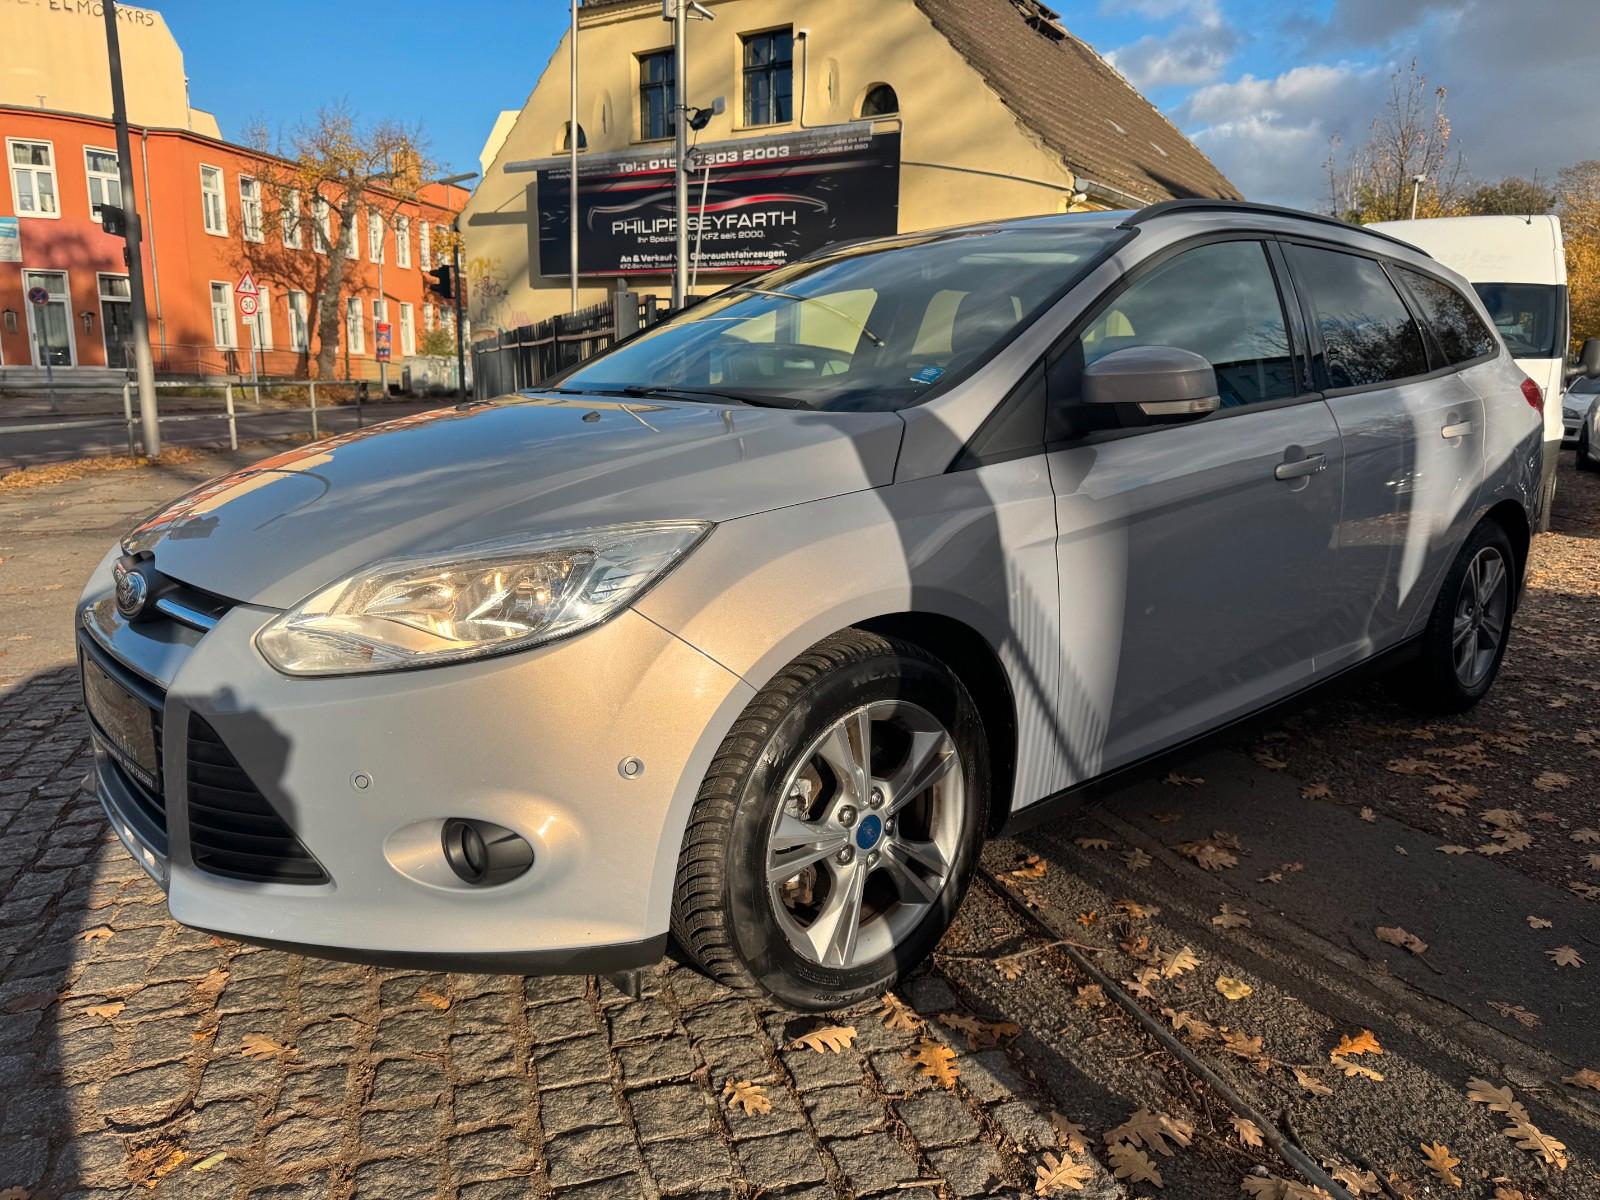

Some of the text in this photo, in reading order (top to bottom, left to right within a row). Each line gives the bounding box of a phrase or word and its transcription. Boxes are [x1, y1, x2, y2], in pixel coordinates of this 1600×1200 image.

[617, 162, 646, 173] Tel.:
[743, 145, 790, 161] 2003
[687, 210, 796, 230] SEYFARTH
[701, 232, 719, 240] KFZ
[721, 232, 737, 240] seit
[632, 254, 640, 262] &
[640, 253, 672, 262] Verkauf
[243, 300, 254, 310] 30
